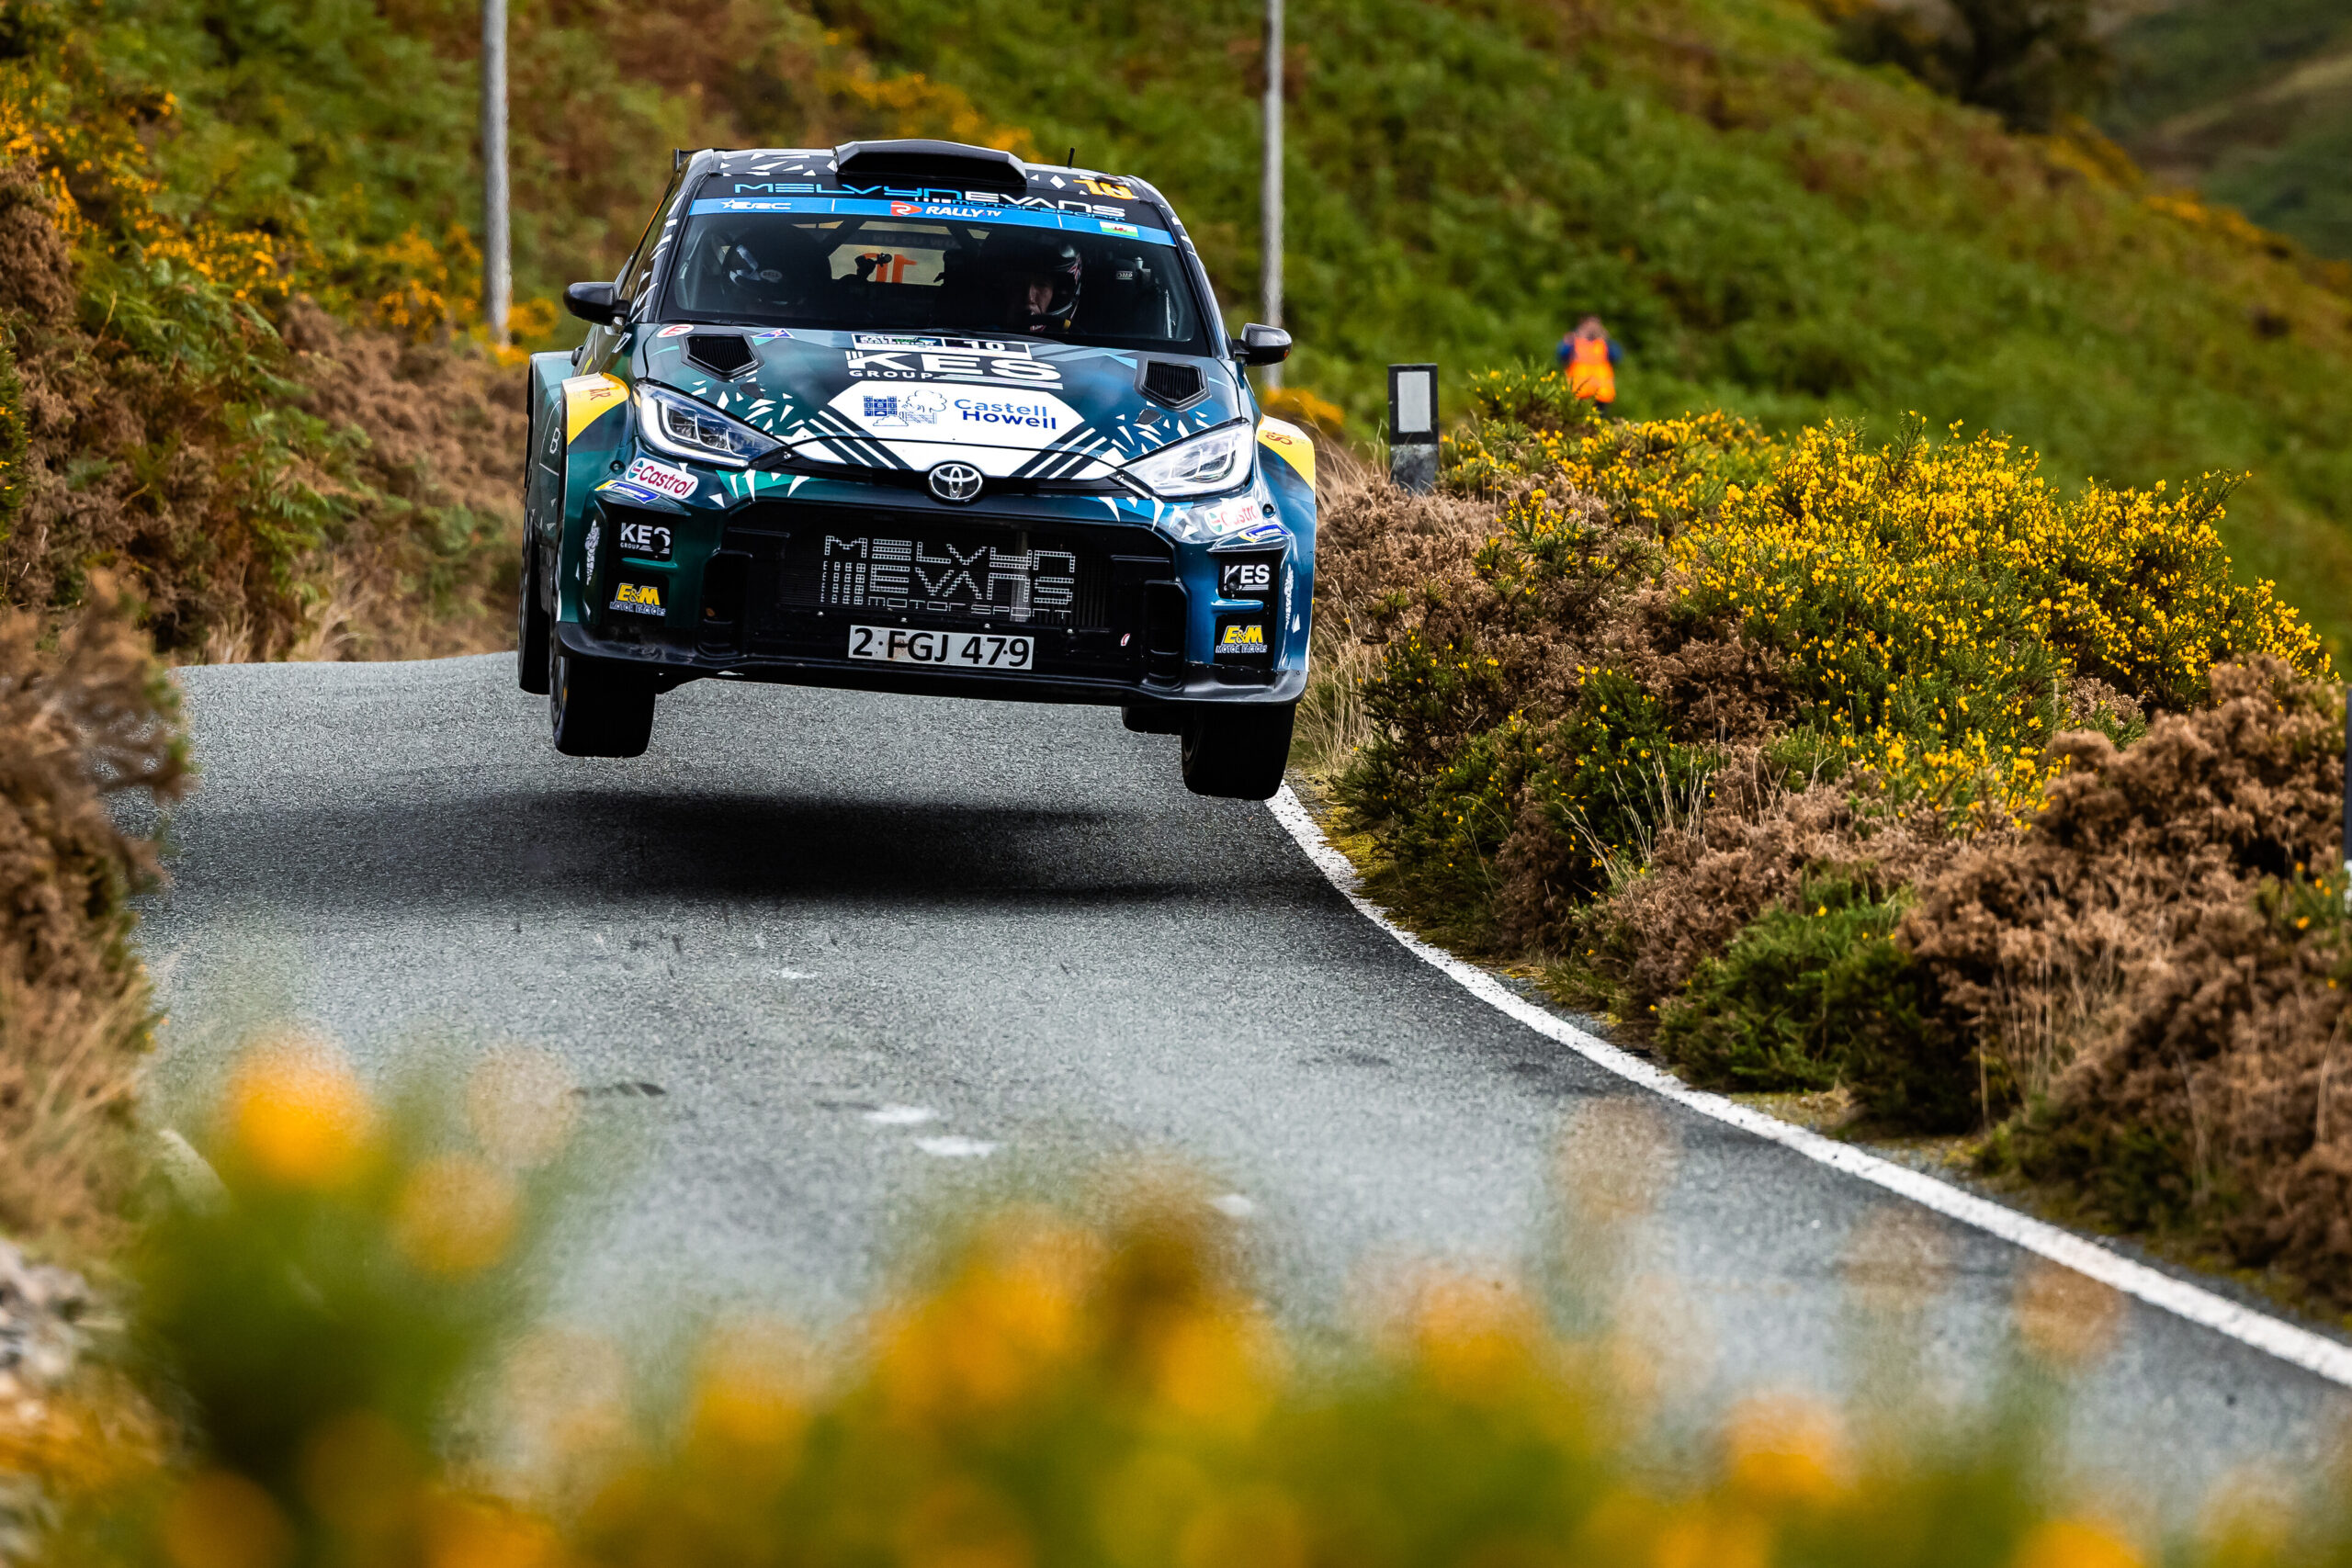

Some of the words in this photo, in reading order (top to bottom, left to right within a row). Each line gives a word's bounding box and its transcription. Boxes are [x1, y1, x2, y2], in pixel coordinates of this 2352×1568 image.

[963, 340, 1006, 351] 10
[844, 350, 1062, 381] KES
[848, 370, 933, 379] GROUP
[954, 399, 1047, 417] Castell
[962, 410, 1057, 430] Howell
[639, 465, 695, 496] Castrol
[619, 542, 640, 550] GROUP
[1223, 563, 1270, 584] KES
[616, 582, 661, 606] E&M
[1221, 625, 1264, 645] E&M
[887, 630, 949, 661] FGJ
[960, 636, 1030, 667] 479
[1215, 644, 1240, 654] MOTOR
[1240, 644, 1268, 653] FACTORS
